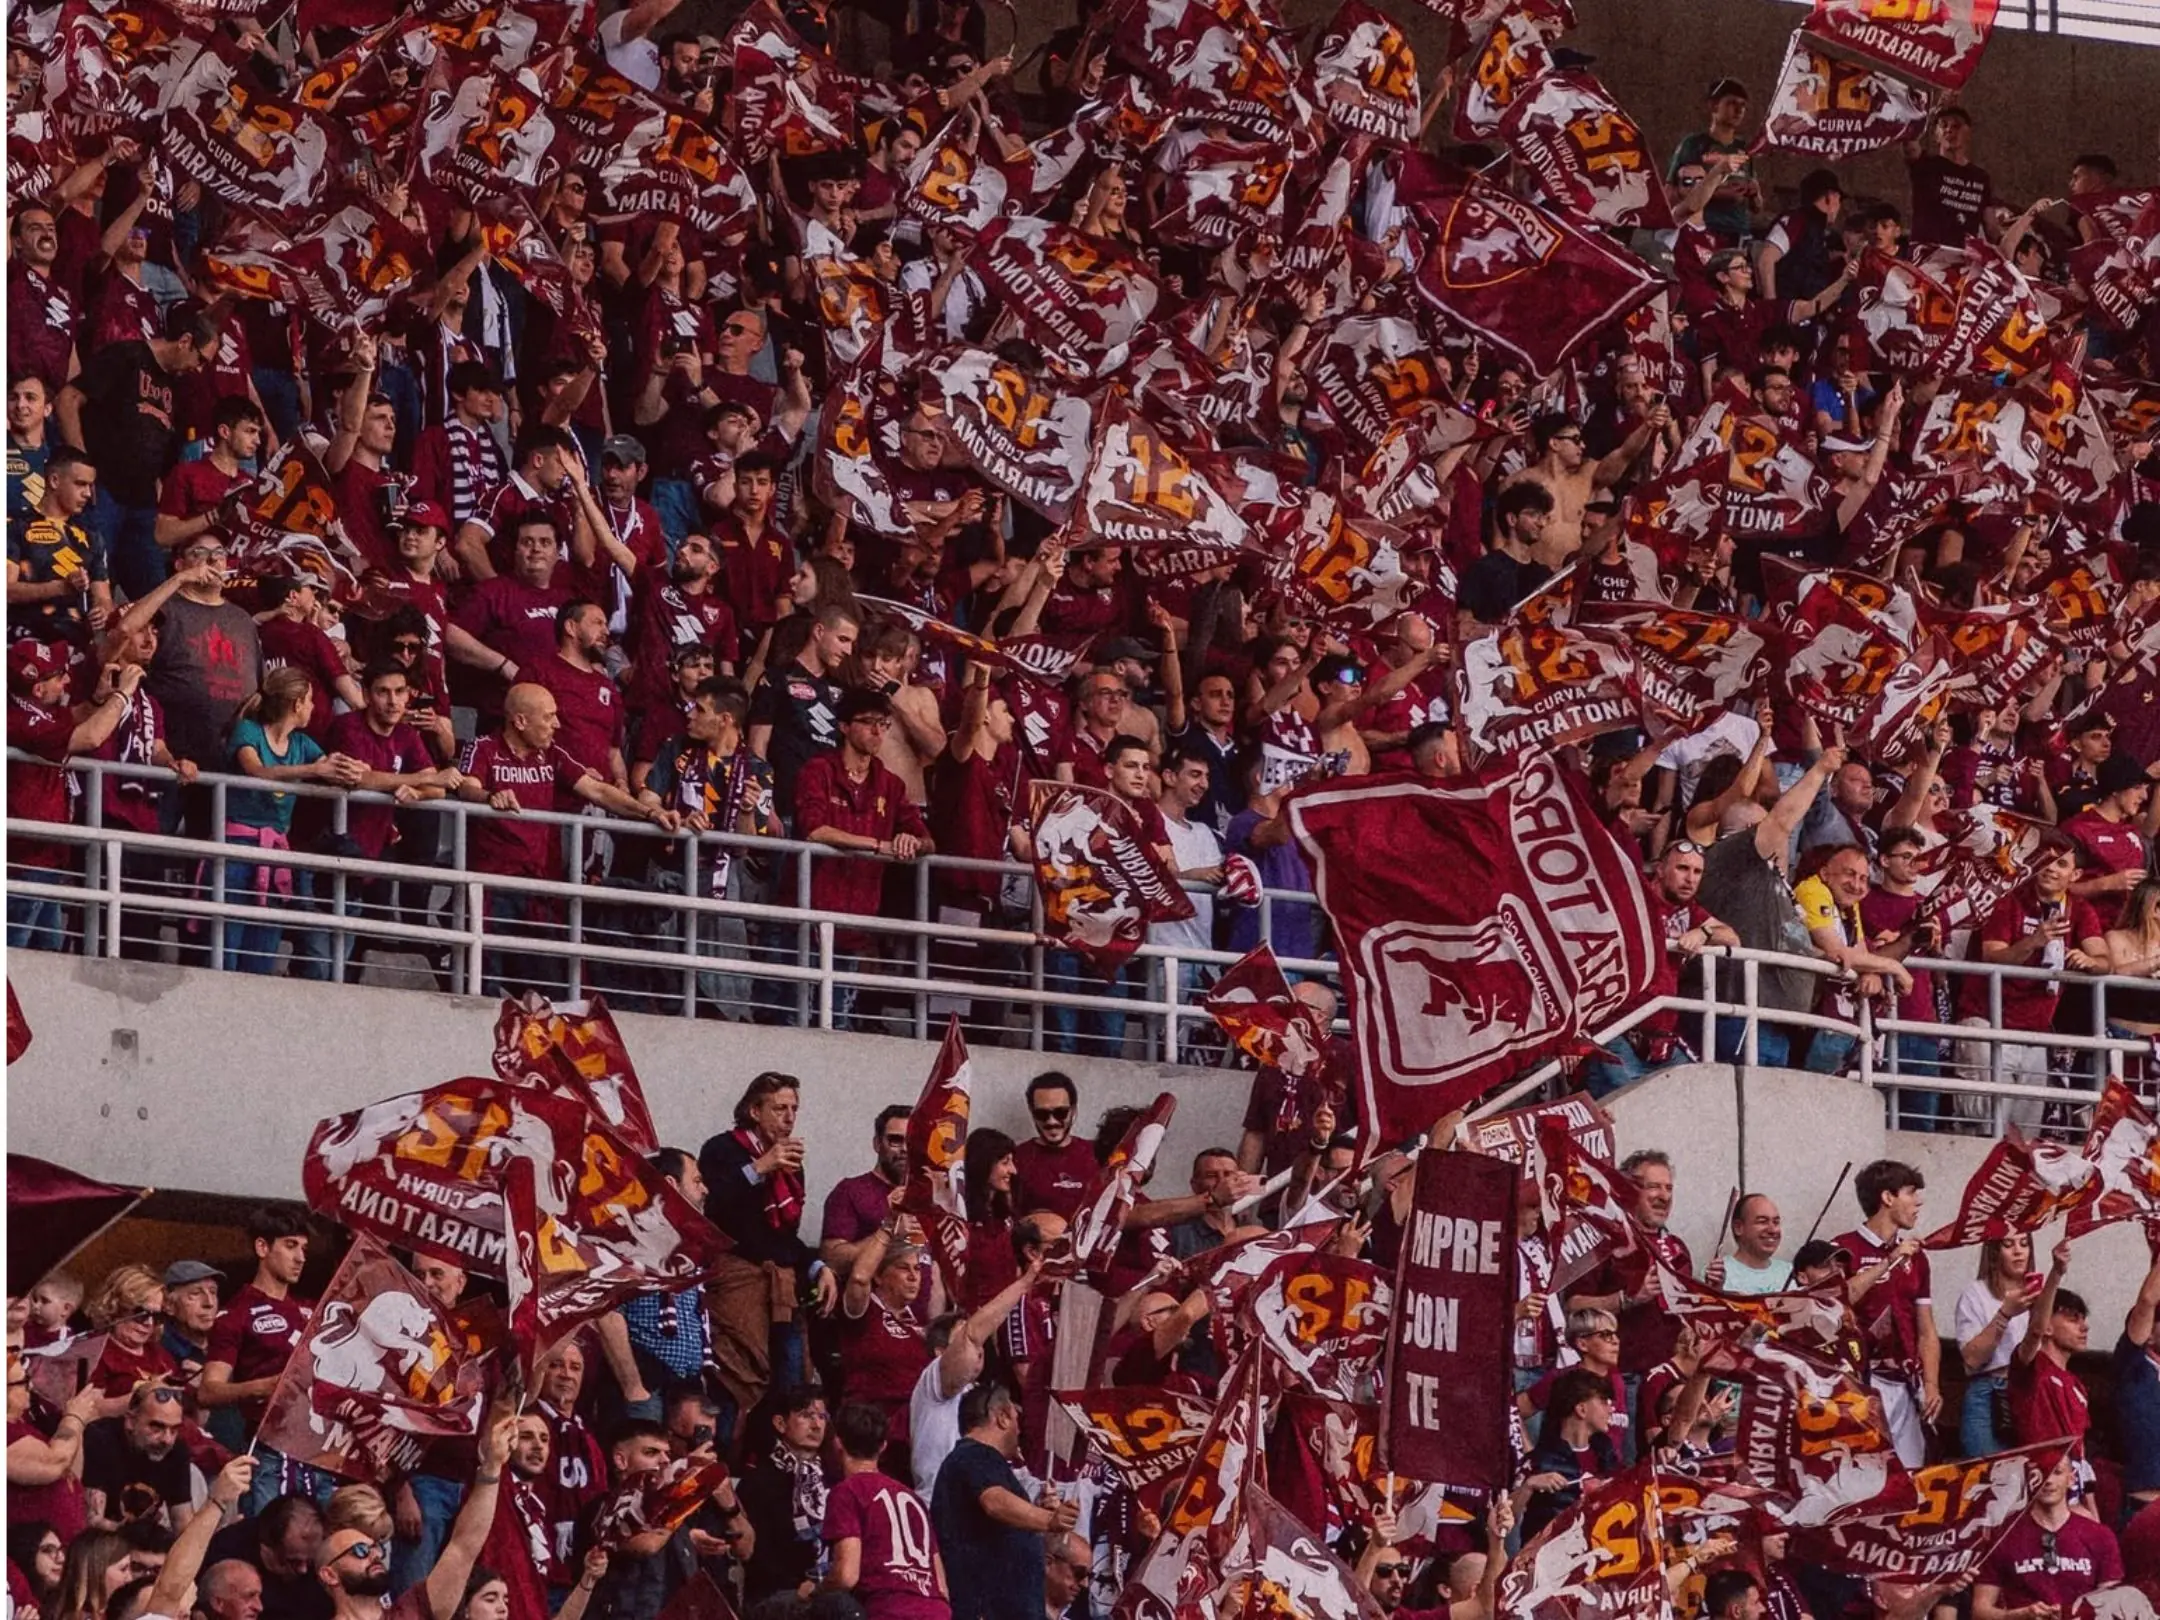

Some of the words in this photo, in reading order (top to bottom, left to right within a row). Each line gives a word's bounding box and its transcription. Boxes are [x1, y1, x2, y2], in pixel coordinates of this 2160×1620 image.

[1819, 118, 1863, 133] CURVA
[207, 140, 250, 180] CURVA
[1727, 505, 1786, 532] TONA
[1532, 686, 1586, 714] CURVA
[1497, 698, 1640, 757] MARATONA
[492, 765, 541, 786] TORINO
[540, 765, 555, 783] FC
[1406, 1371, 1440, 1431] TE
[873, 1488, 931, 1568] 10
